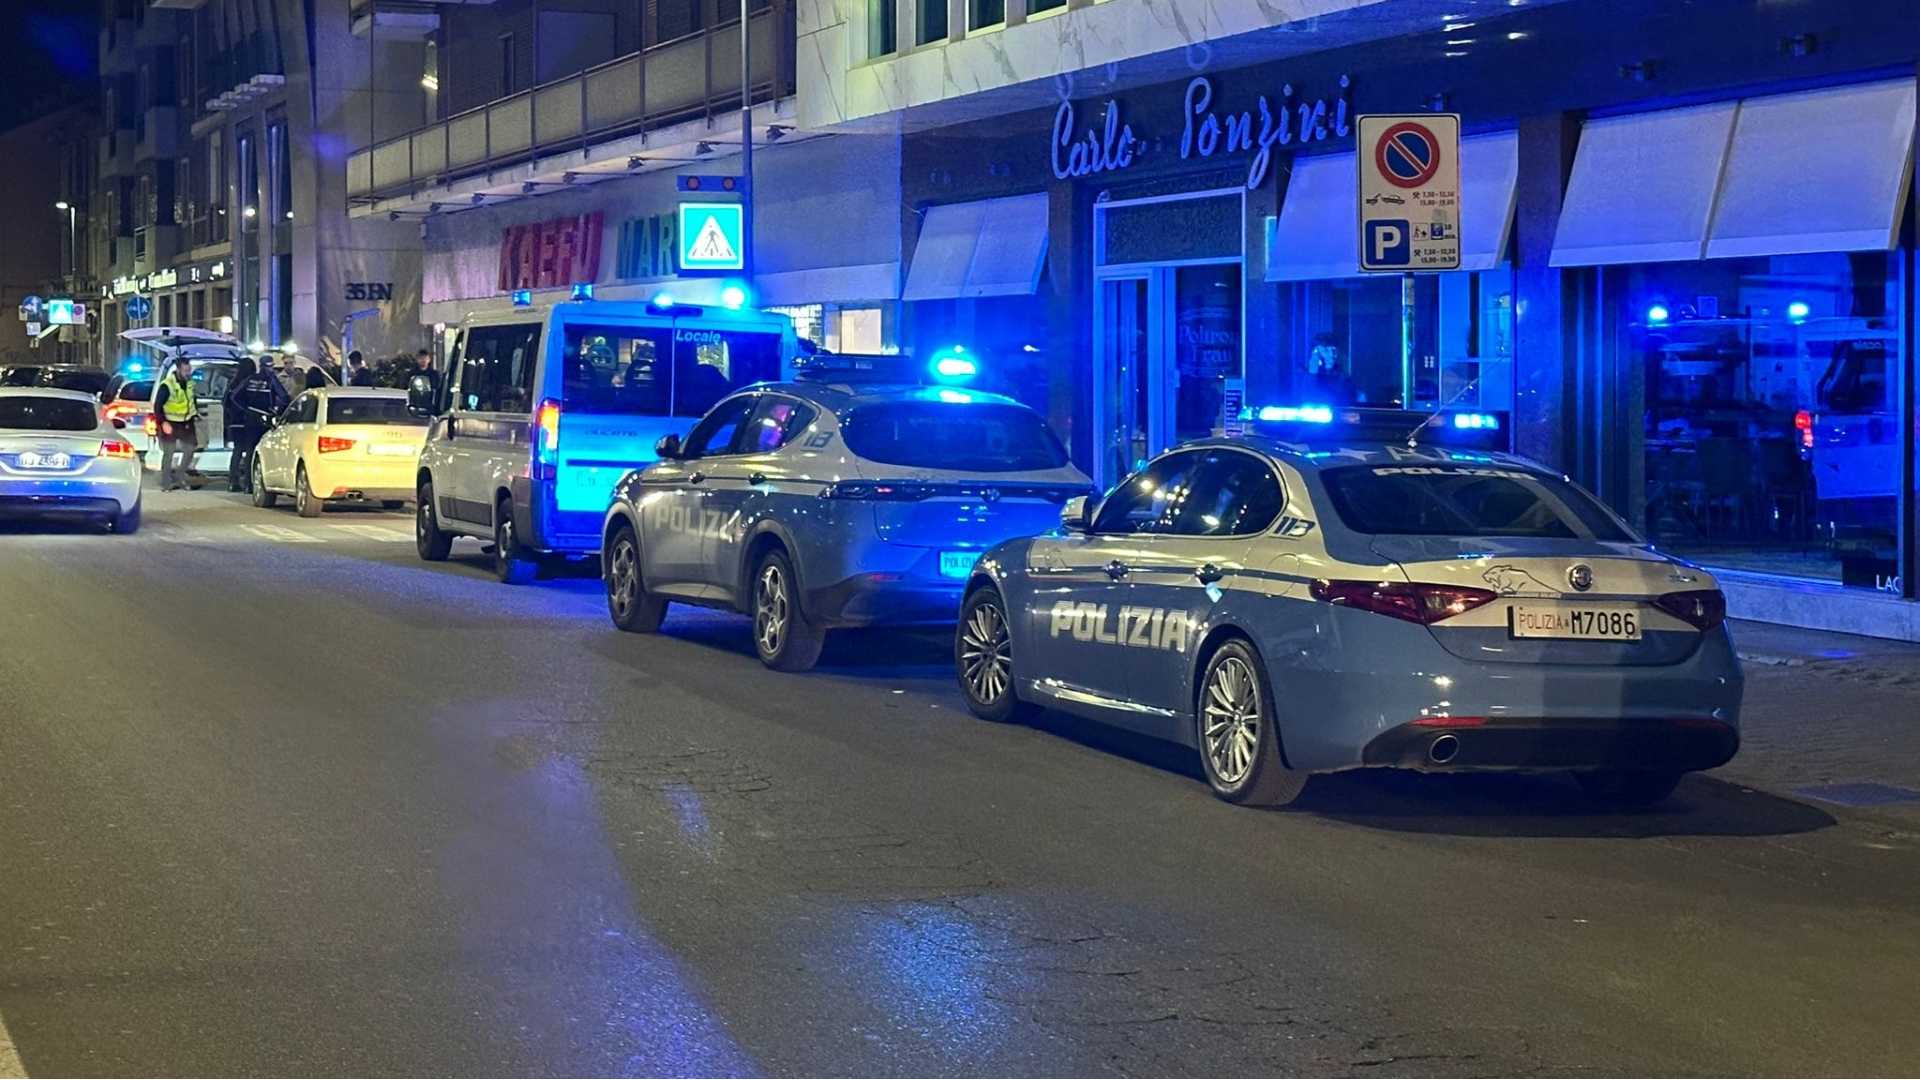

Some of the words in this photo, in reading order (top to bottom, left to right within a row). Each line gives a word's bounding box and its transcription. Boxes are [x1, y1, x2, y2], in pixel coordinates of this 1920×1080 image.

[1052, 100, 1133, 179] Carlo
[1181, 75, 1349, 189] Ponzini
[1375, 226, 1401, 260] P
[1372, 467, 1538, 481] POLIZIA
[1050, 600, 1188, 653] POLIZIA
[1519, 613, 1564, 630] POLIZIA
[1571, 610, 1636, 635] M7086
